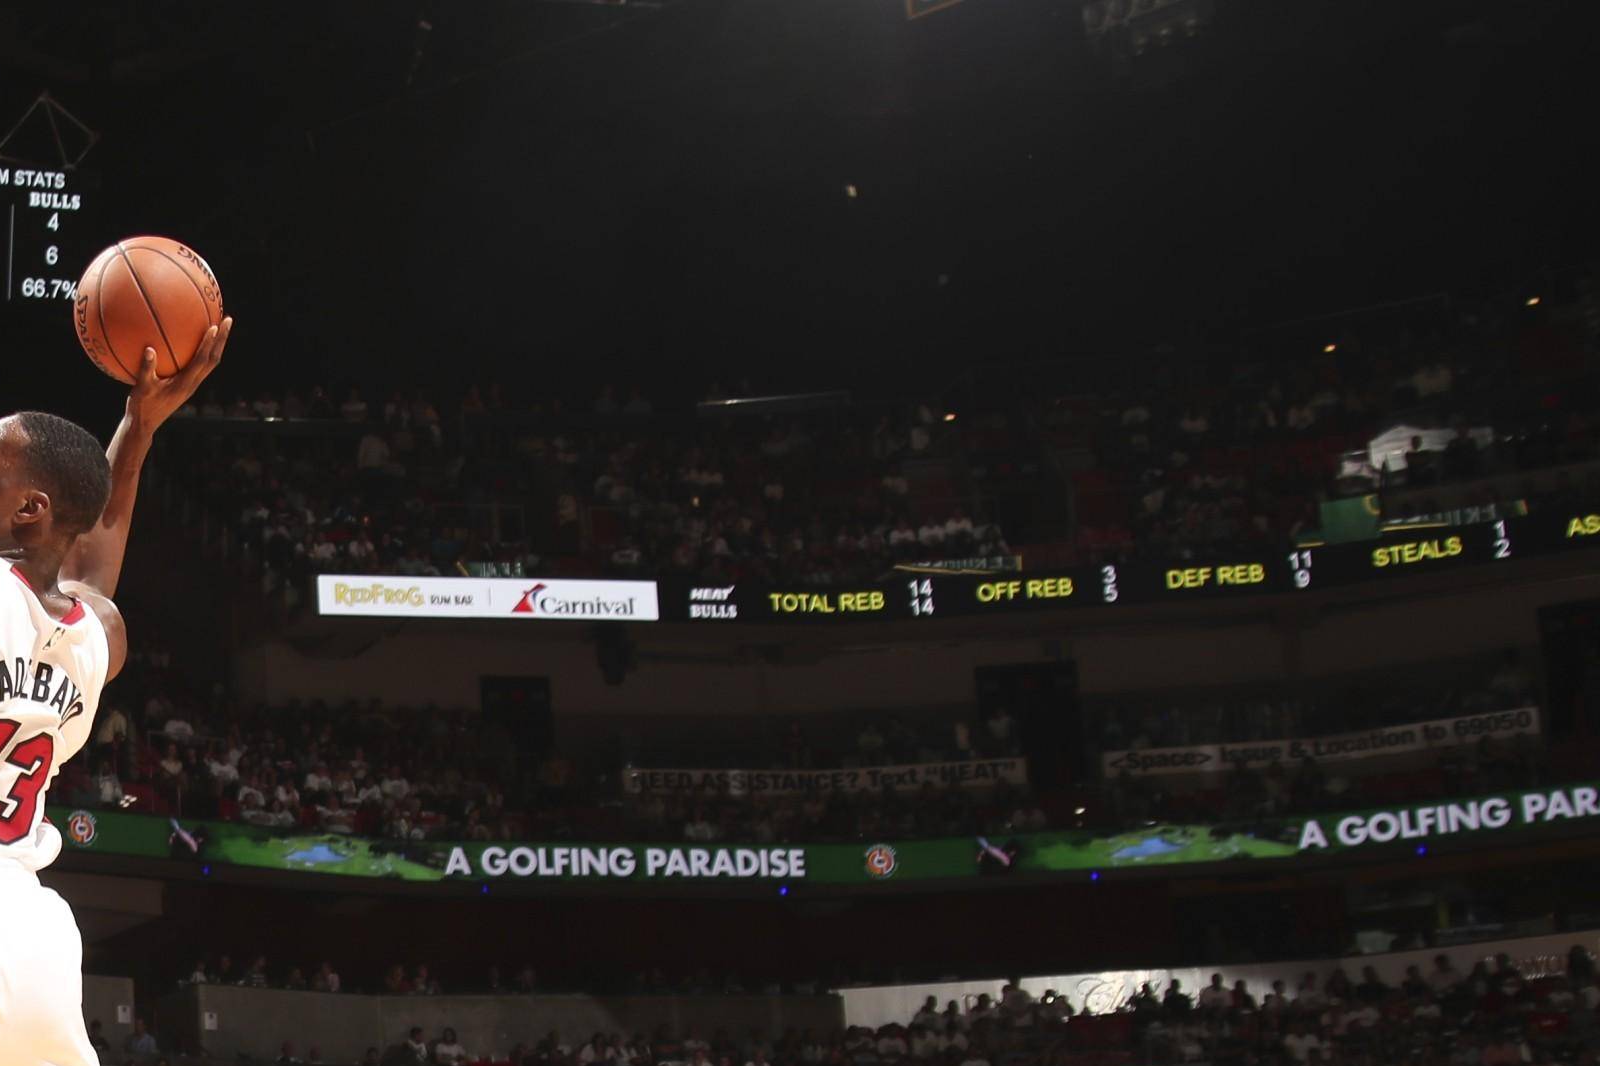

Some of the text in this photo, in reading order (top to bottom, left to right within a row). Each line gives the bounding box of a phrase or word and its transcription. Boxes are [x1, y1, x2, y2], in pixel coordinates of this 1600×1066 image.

[14, 169, 65, 189] STATS
[29, 191, 81, 211] BULLS
[47, 212, 59, 232] 4
[45, 245, 58, 266] 6
[21, 277, 77, 300] 66.7%
[1371, 536, 1463, 568] STEALS
[1494, 521, 1506, 539] 1
[1495, 539, 1511, 559] 2
[1166, 551, 1311, 590] DEF REB 11
[1295, 569, 1310, 588] 9
[690, 585, 735, 599] HEAT
[976, 566, 1116, 602] OFF REB 3
[1104, 584, 1118, 602] 5
[539, 596, 635, 616] Carnival
[769, 579, 932, 613] TOTAL REB 14
[690, 605, 737, 619] BULLS
[910, 599, 935, 617] 14
[1109, 751, 1212, 771] <Space>
[1220, 744, 1283, 764] Issue
[1313, 730, 1417, 758] Location
[1422, 724, 1446, 741] to
[697, 769, 860, 793] ASSISTANCE?
[868, 769, 920, 789] Text
[1300, 820, 1327, 851] A
[1336, 797, 1511, 848] GOLFING
[445, 847, 805, 878] A GOLFING PARADISE
